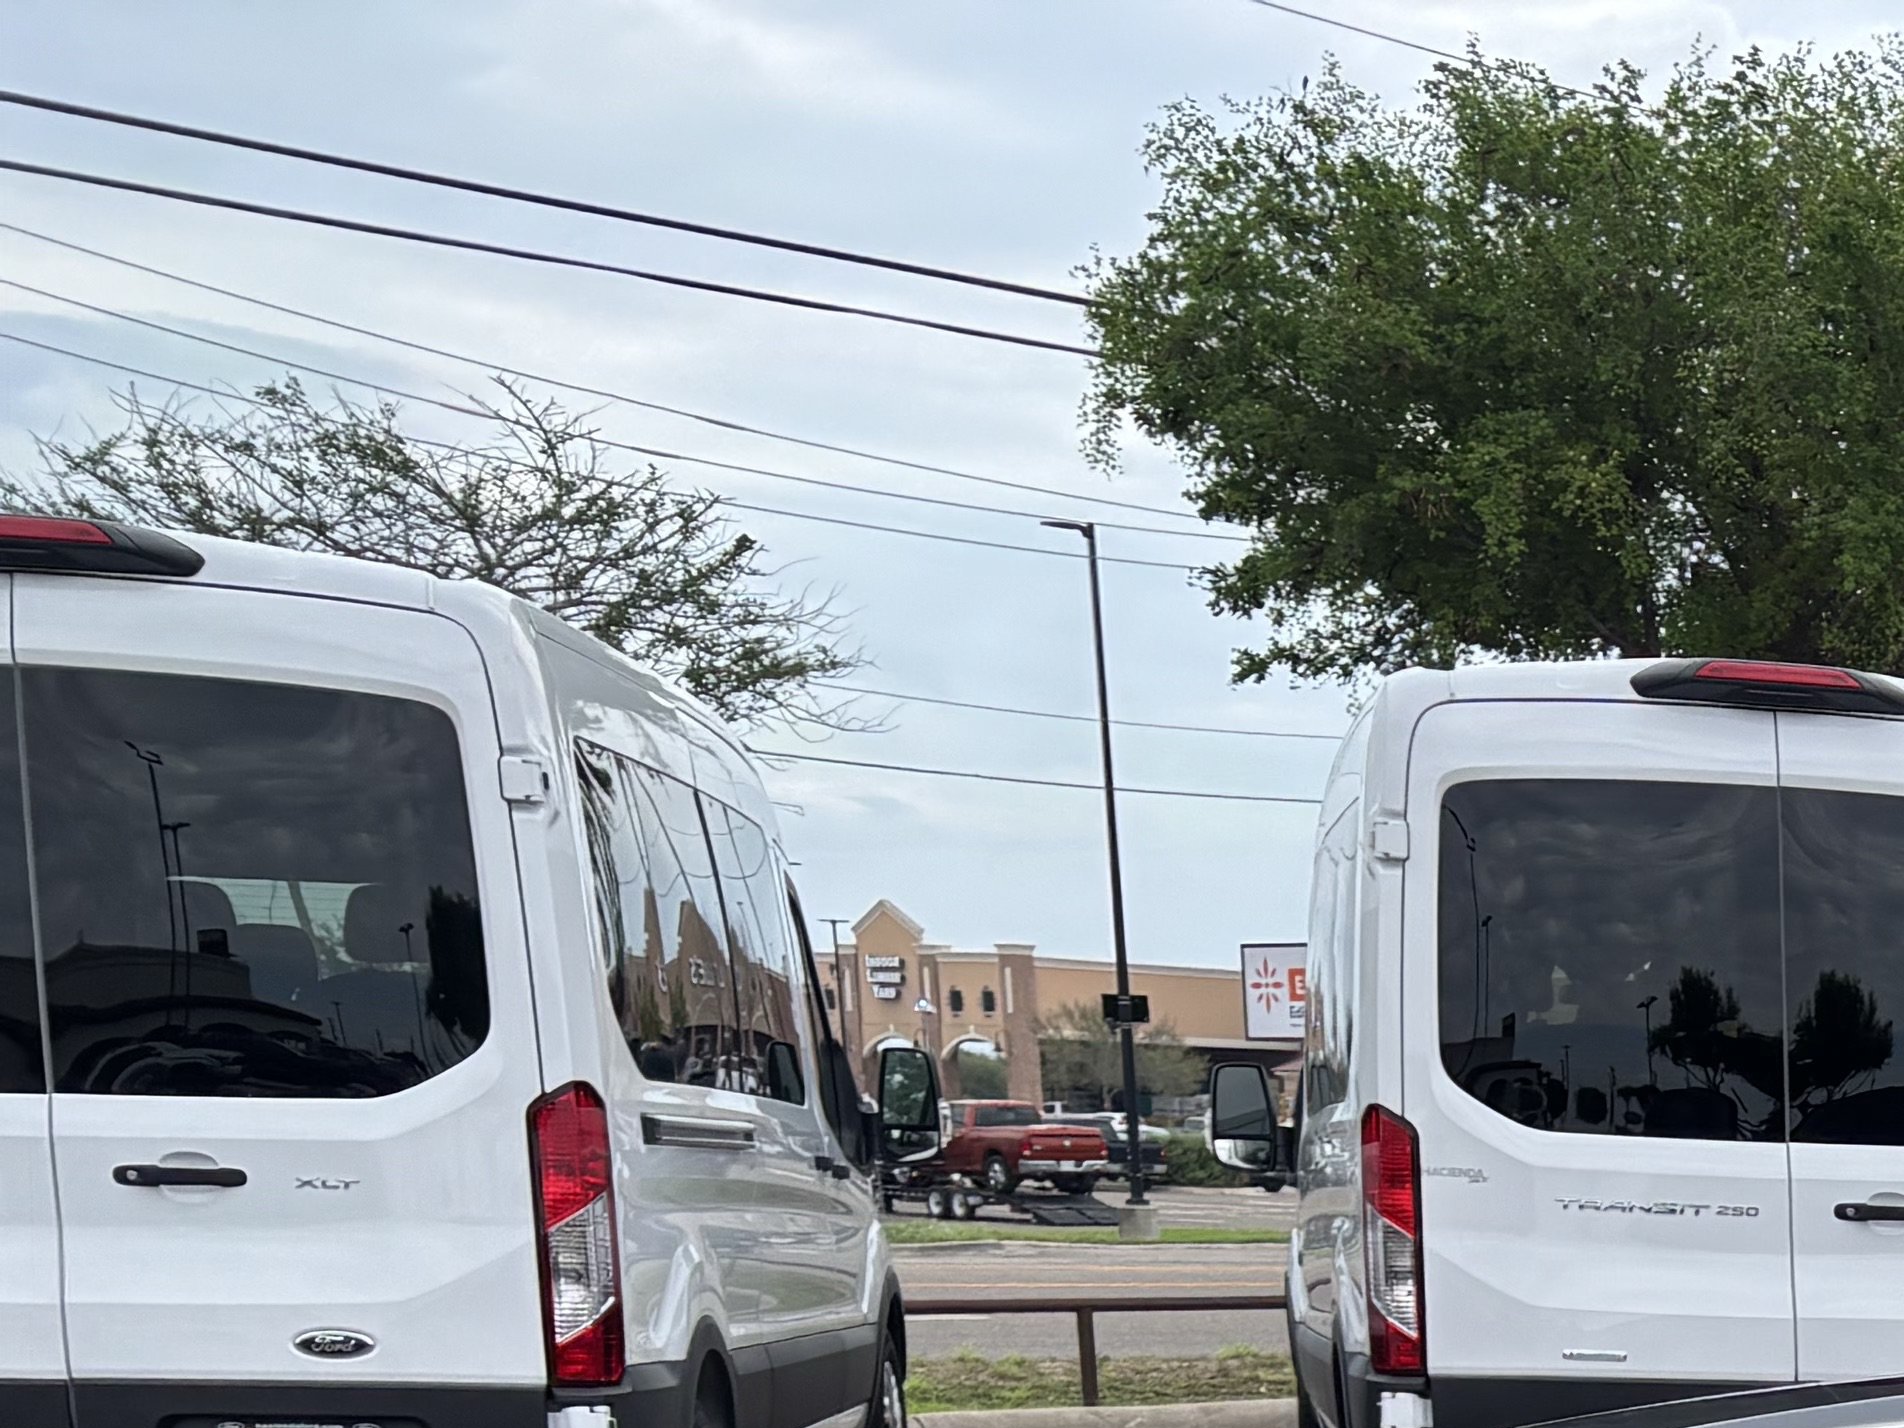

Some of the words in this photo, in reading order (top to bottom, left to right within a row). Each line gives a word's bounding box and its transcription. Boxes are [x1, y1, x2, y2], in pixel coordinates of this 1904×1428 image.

[295, 1176, 361, 1190] XLT
[1554, 1197, 1712, 1217] TRANSIT
[1715, 1204, 1760, 1218] 250
[311, 1333, 357, 1353] Ford
